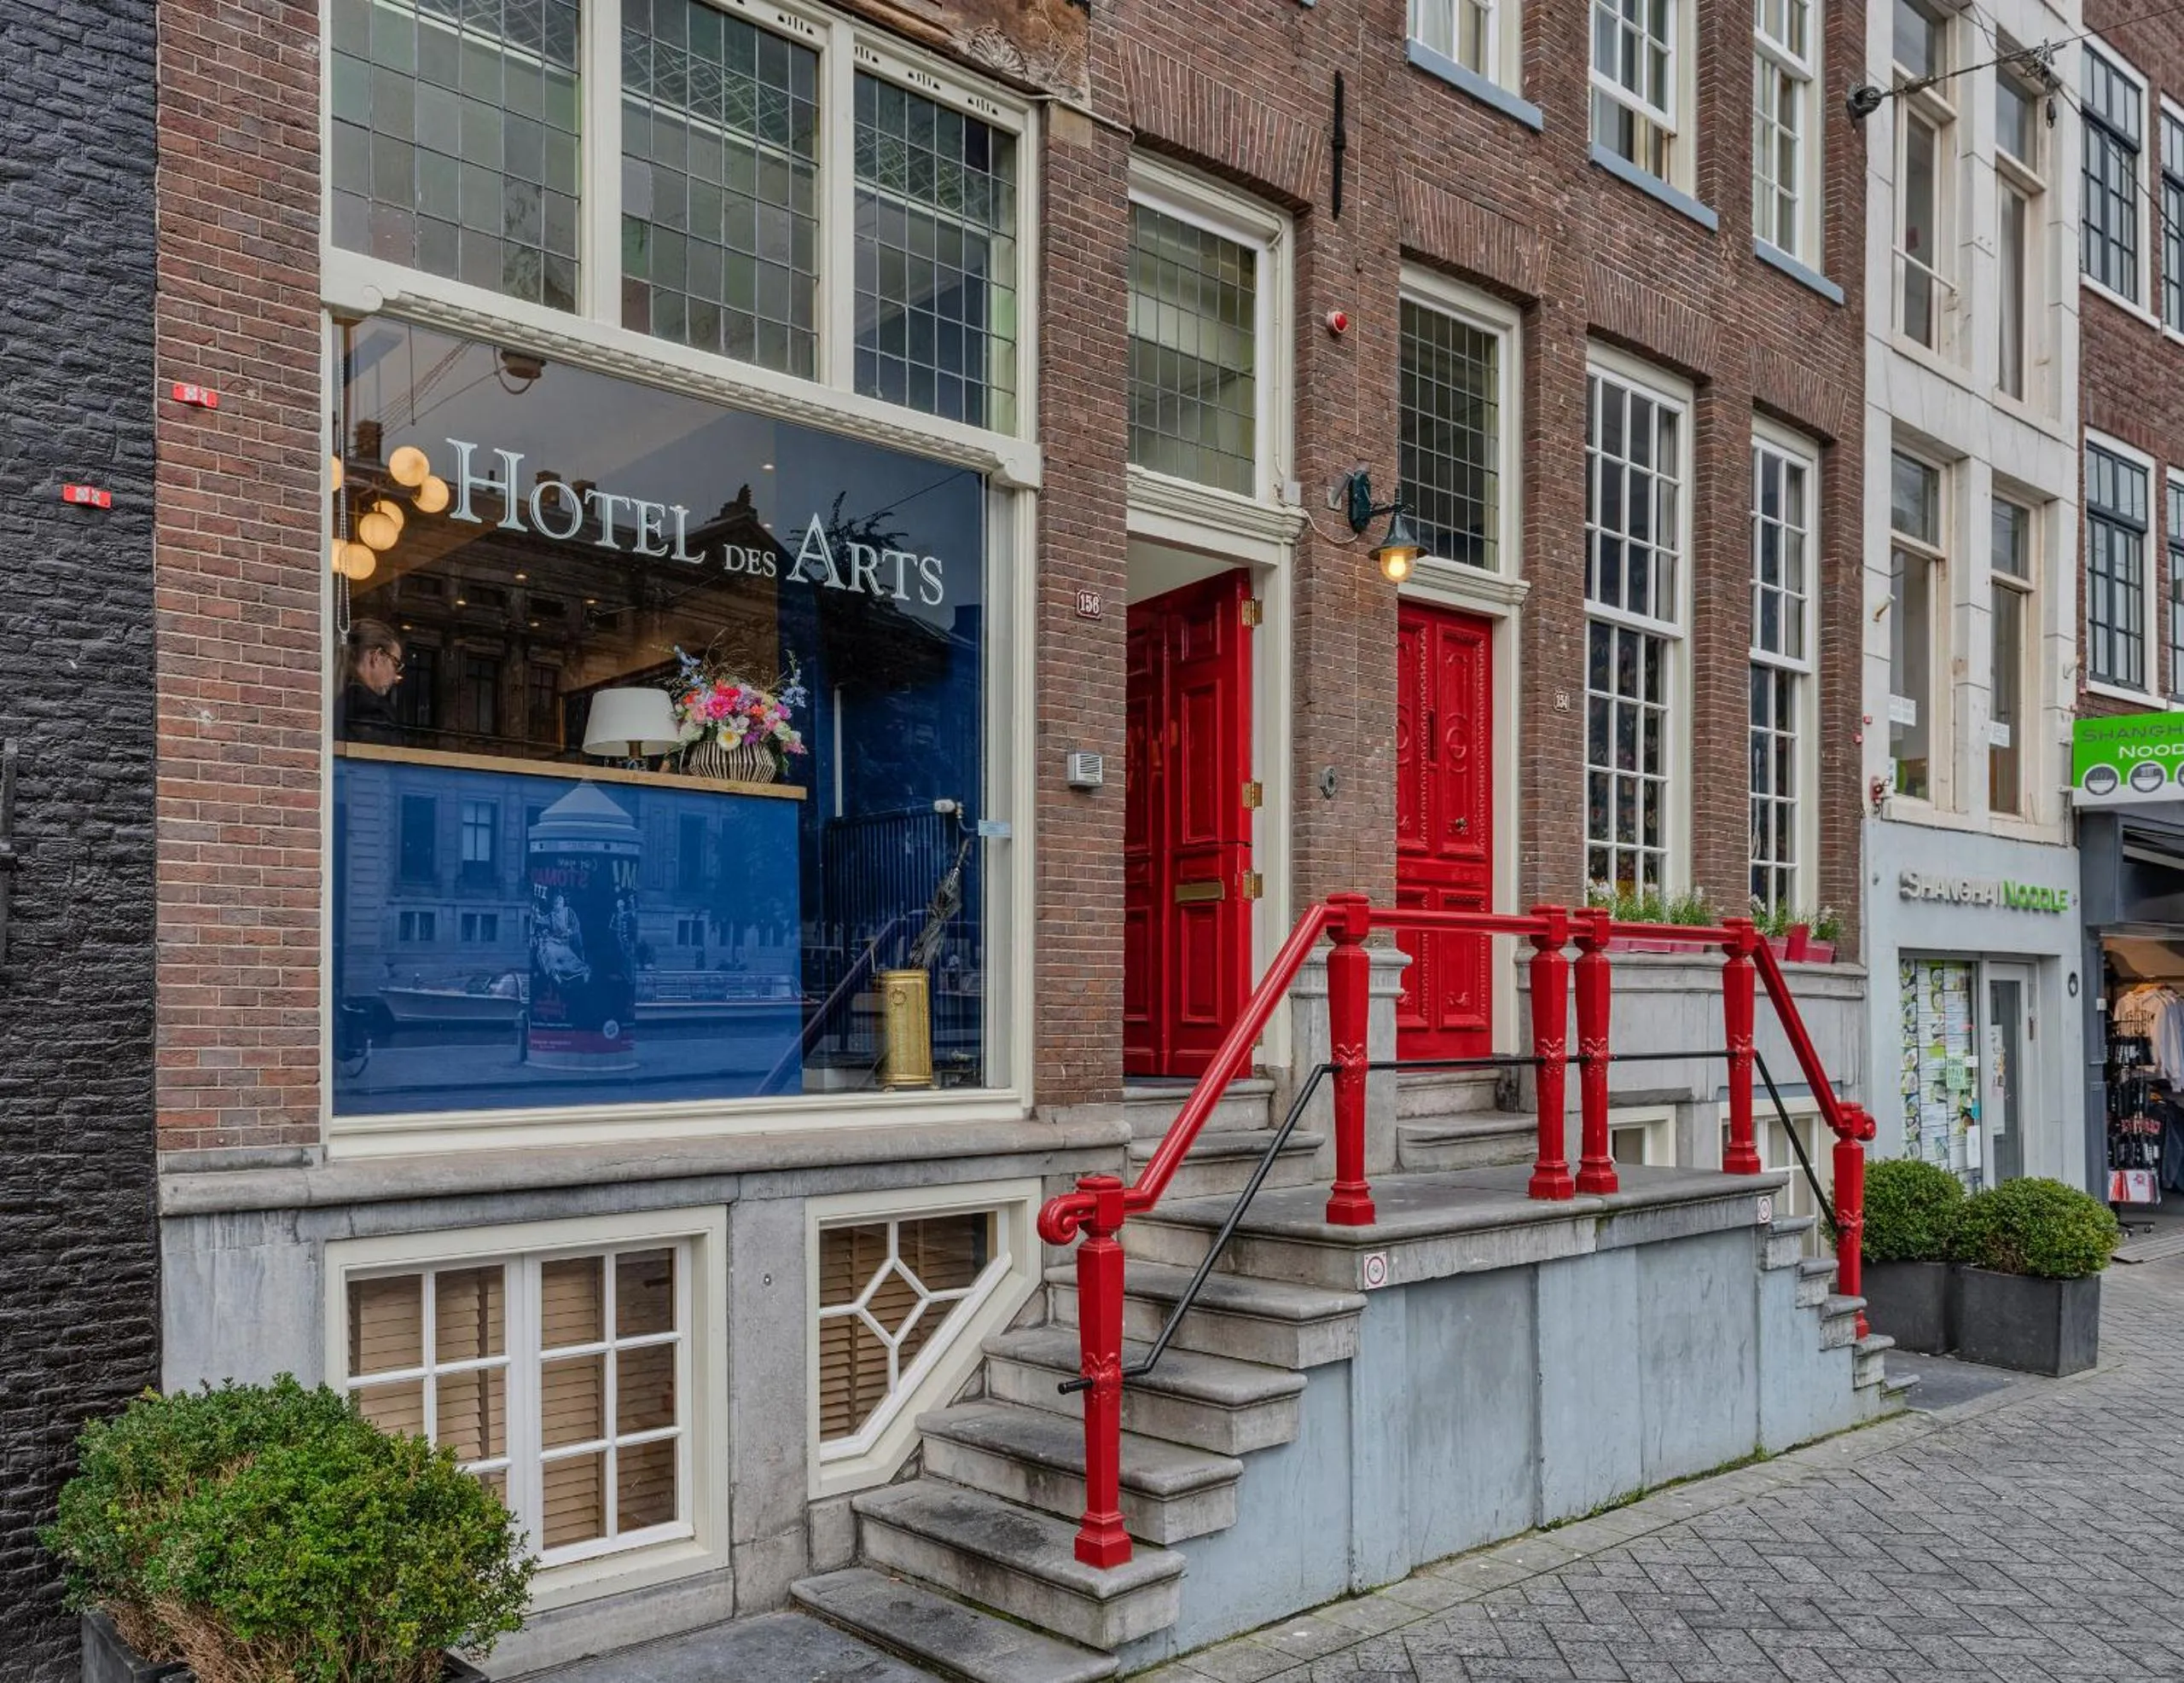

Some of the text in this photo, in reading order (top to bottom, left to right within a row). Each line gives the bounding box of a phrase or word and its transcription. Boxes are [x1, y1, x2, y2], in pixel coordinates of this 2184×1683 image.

[445, 437, 944, 606] HOTEL DES ARTS
[1900, 871, 2069, 912] SHANGHAI NOODLE
